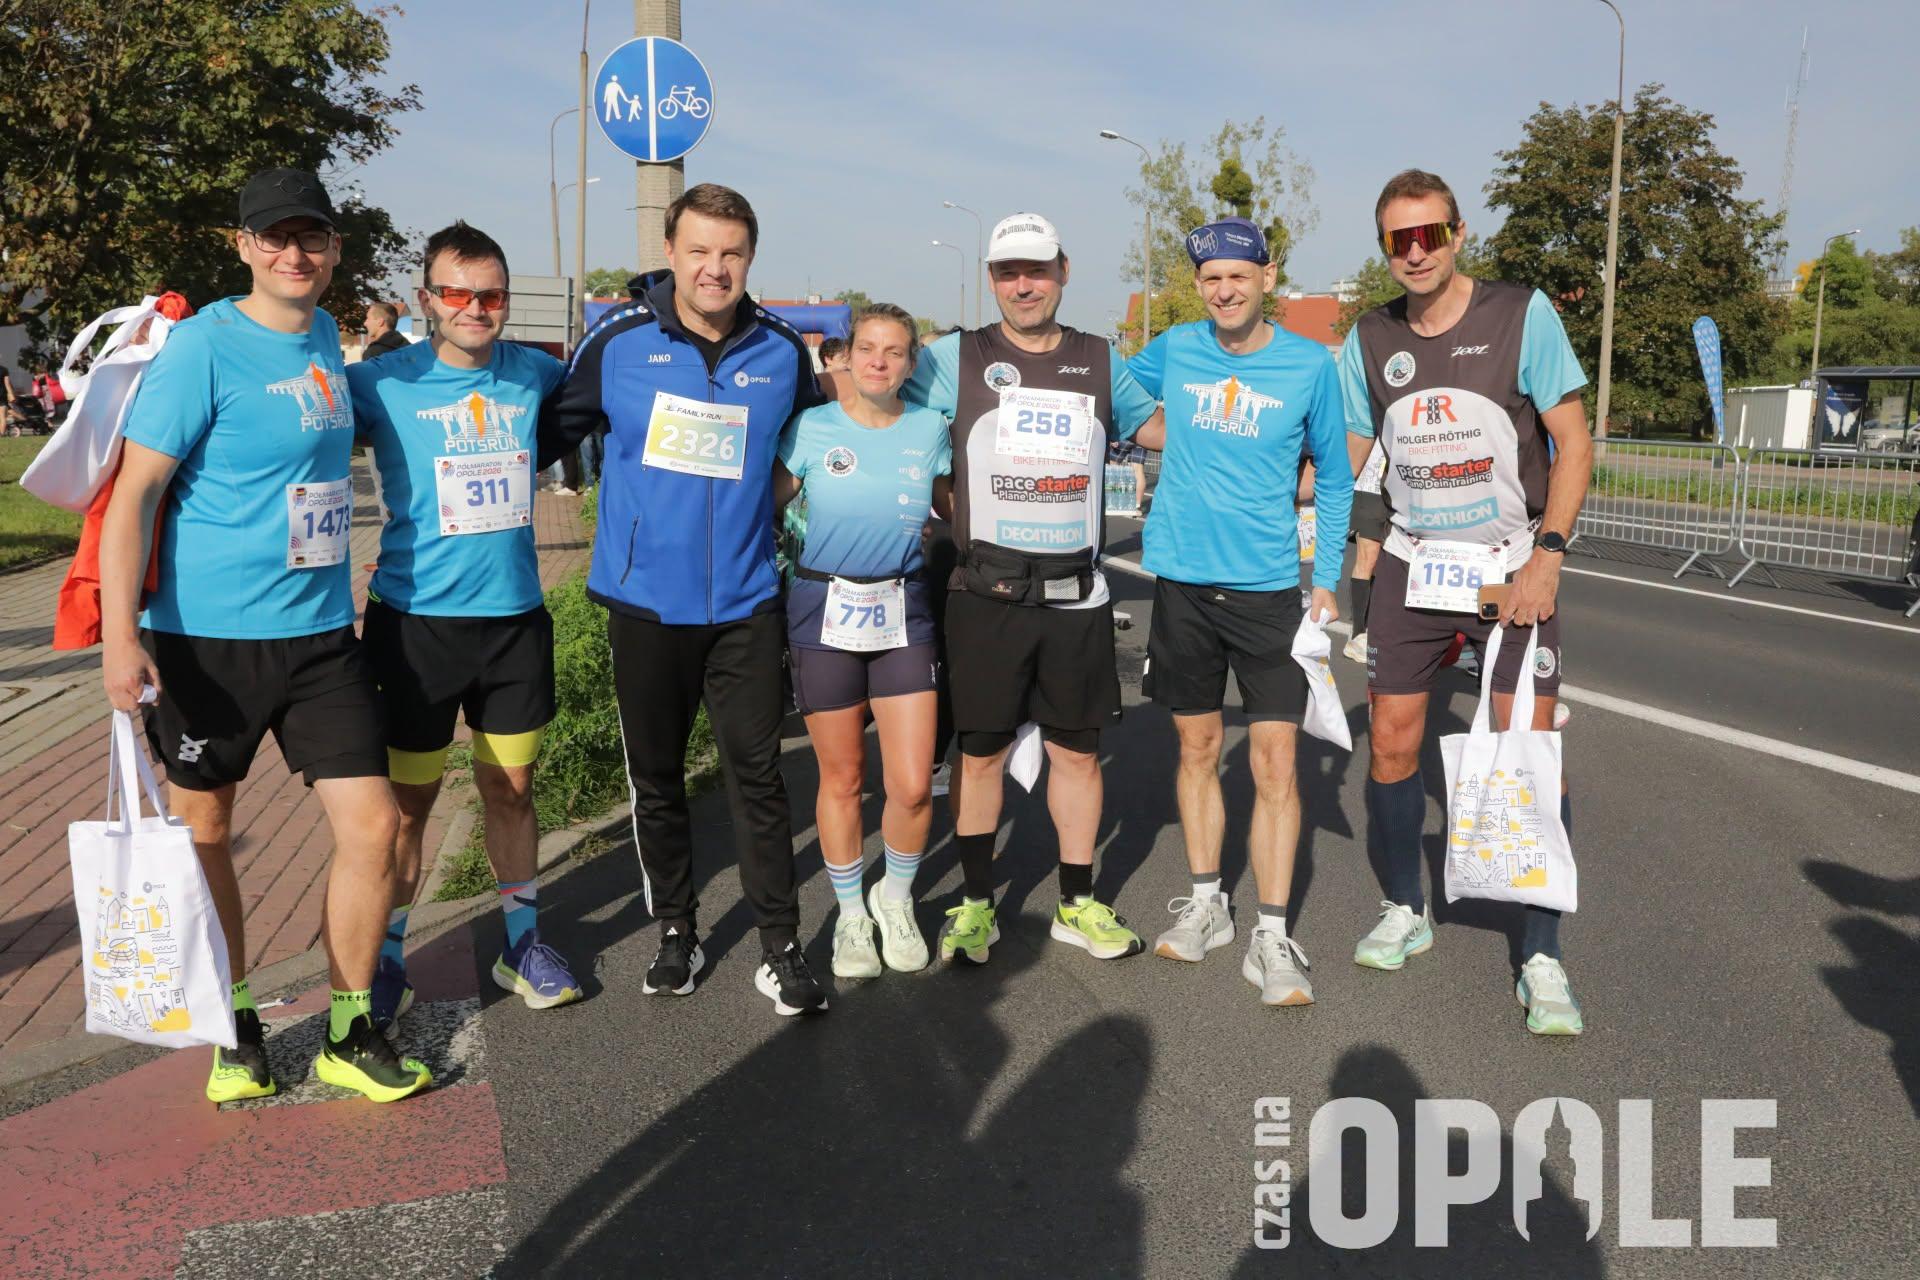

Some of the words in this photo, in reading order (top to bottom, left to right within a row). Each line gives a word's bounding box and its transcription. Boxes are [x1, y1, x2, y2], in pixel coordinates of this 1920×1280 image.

[647, 354, 671, 363] JAKO
[677, 407, 705, 418] FAMILY
[1016, 409, 1071, 437] 258
[1192, 414, 1259, 438] POTSRUN
[660, 424, 735, 460] 2326
[1396, 433, 1436, 444] HOLGER
[1439, 428, 1481, 442] RÖTHIG
[444, 437, 520, 453] POTSRUN
[1408, 447, 1429, 455] BIKE
[1013, 455, 1035, 465] BIKE
[456, 469, 482, 478] OPOLE
[1425, 479, 1451, 489] Dein
[1451, 471, 1492, 488] Training
[466, 477, 510, 507] 311
[999, 490, 1027, 502] Plane
[1027, 492, 1054, 503] Dein
[1054, 489, 1088, 503] Training
[308, 499, 332, 507] OPOLE
[303, 504, 350, 539] 1473
[1001, 526, 1083, 544] DECATHLON
[1424, 562, 1484, 589] 1138
[839, 603, 886, 628] 778
